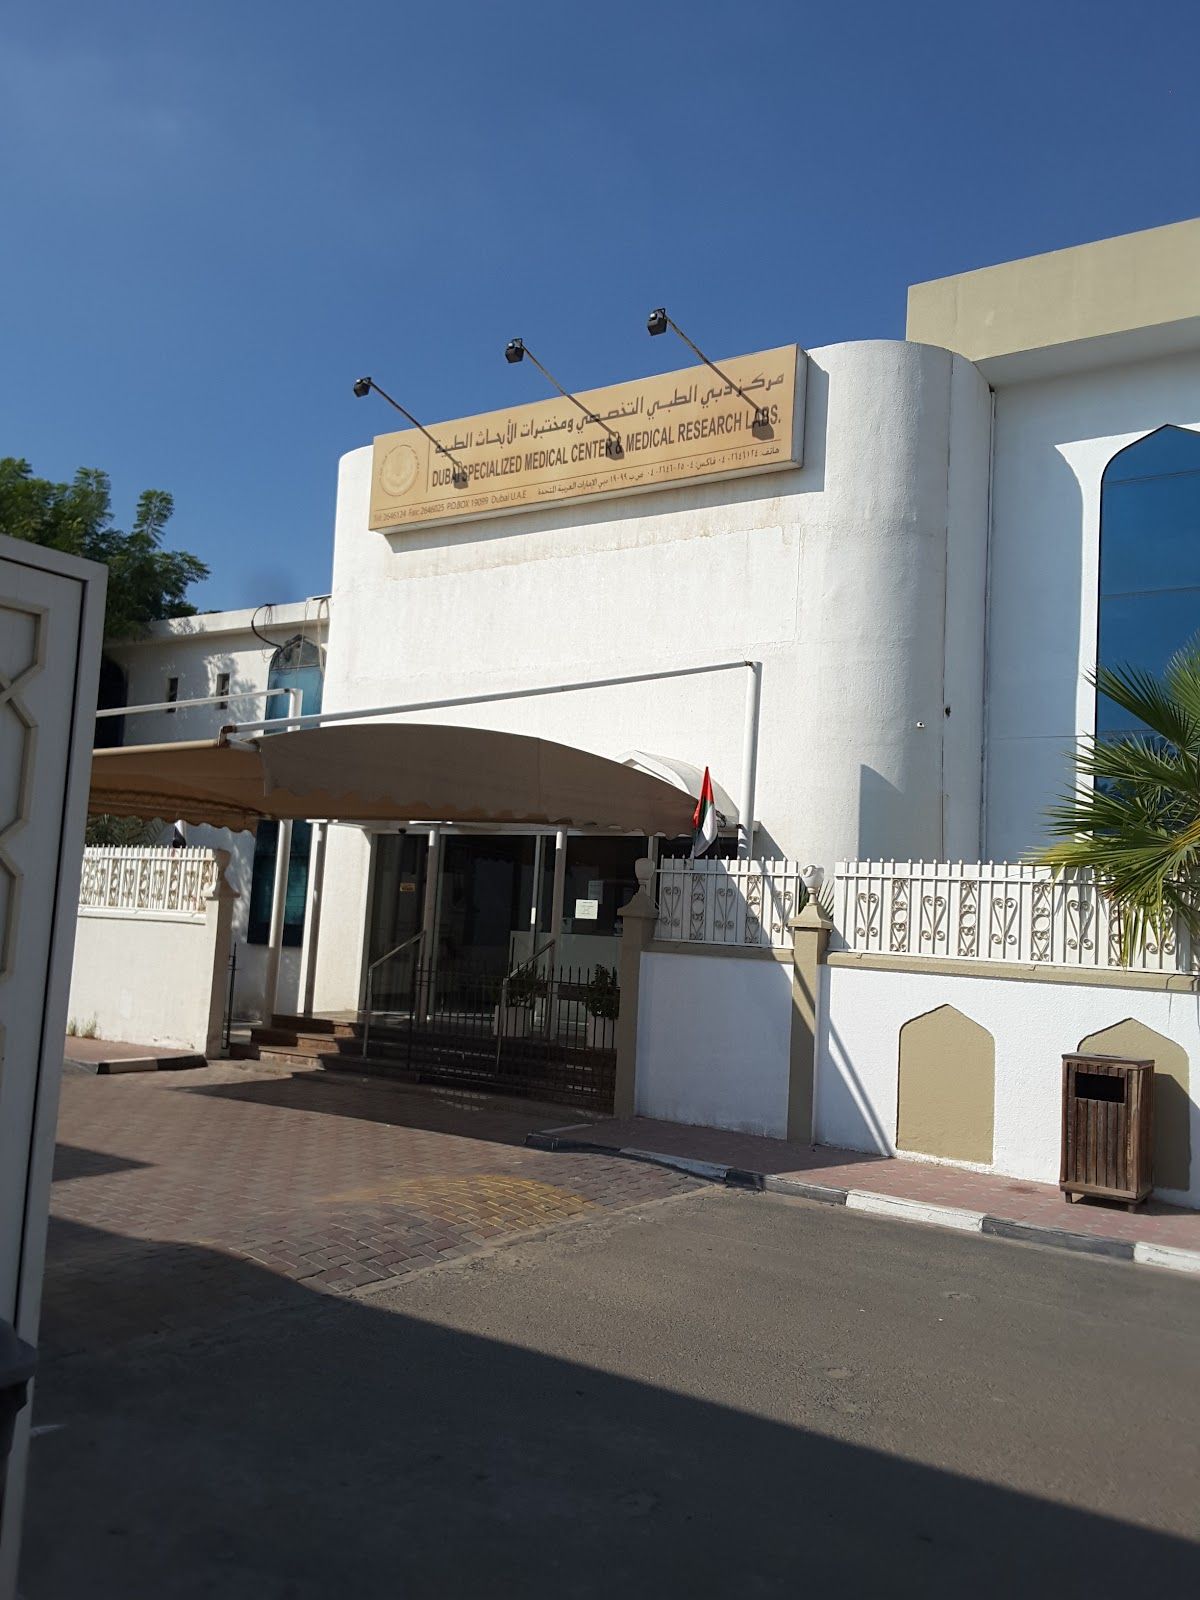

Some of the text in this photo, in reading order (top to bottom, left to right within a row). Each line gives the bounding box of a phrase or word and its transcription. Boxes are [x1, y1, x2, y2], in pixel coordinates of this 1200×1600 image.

[435, 372, 784, 457] مركز دبي الطبي التخصصي ومختبرات الأبحاث الطبية
[462, 455, 521, 482] SPECIALIZED
[525, 447, 568, 471] MEDICAL
[571, 438, 612, 463] CENTER
[614, 434, 623, 455] &
[626, 426, 674, 453] MEDICAL
[678, 411, 742, 443] RESEARCH
